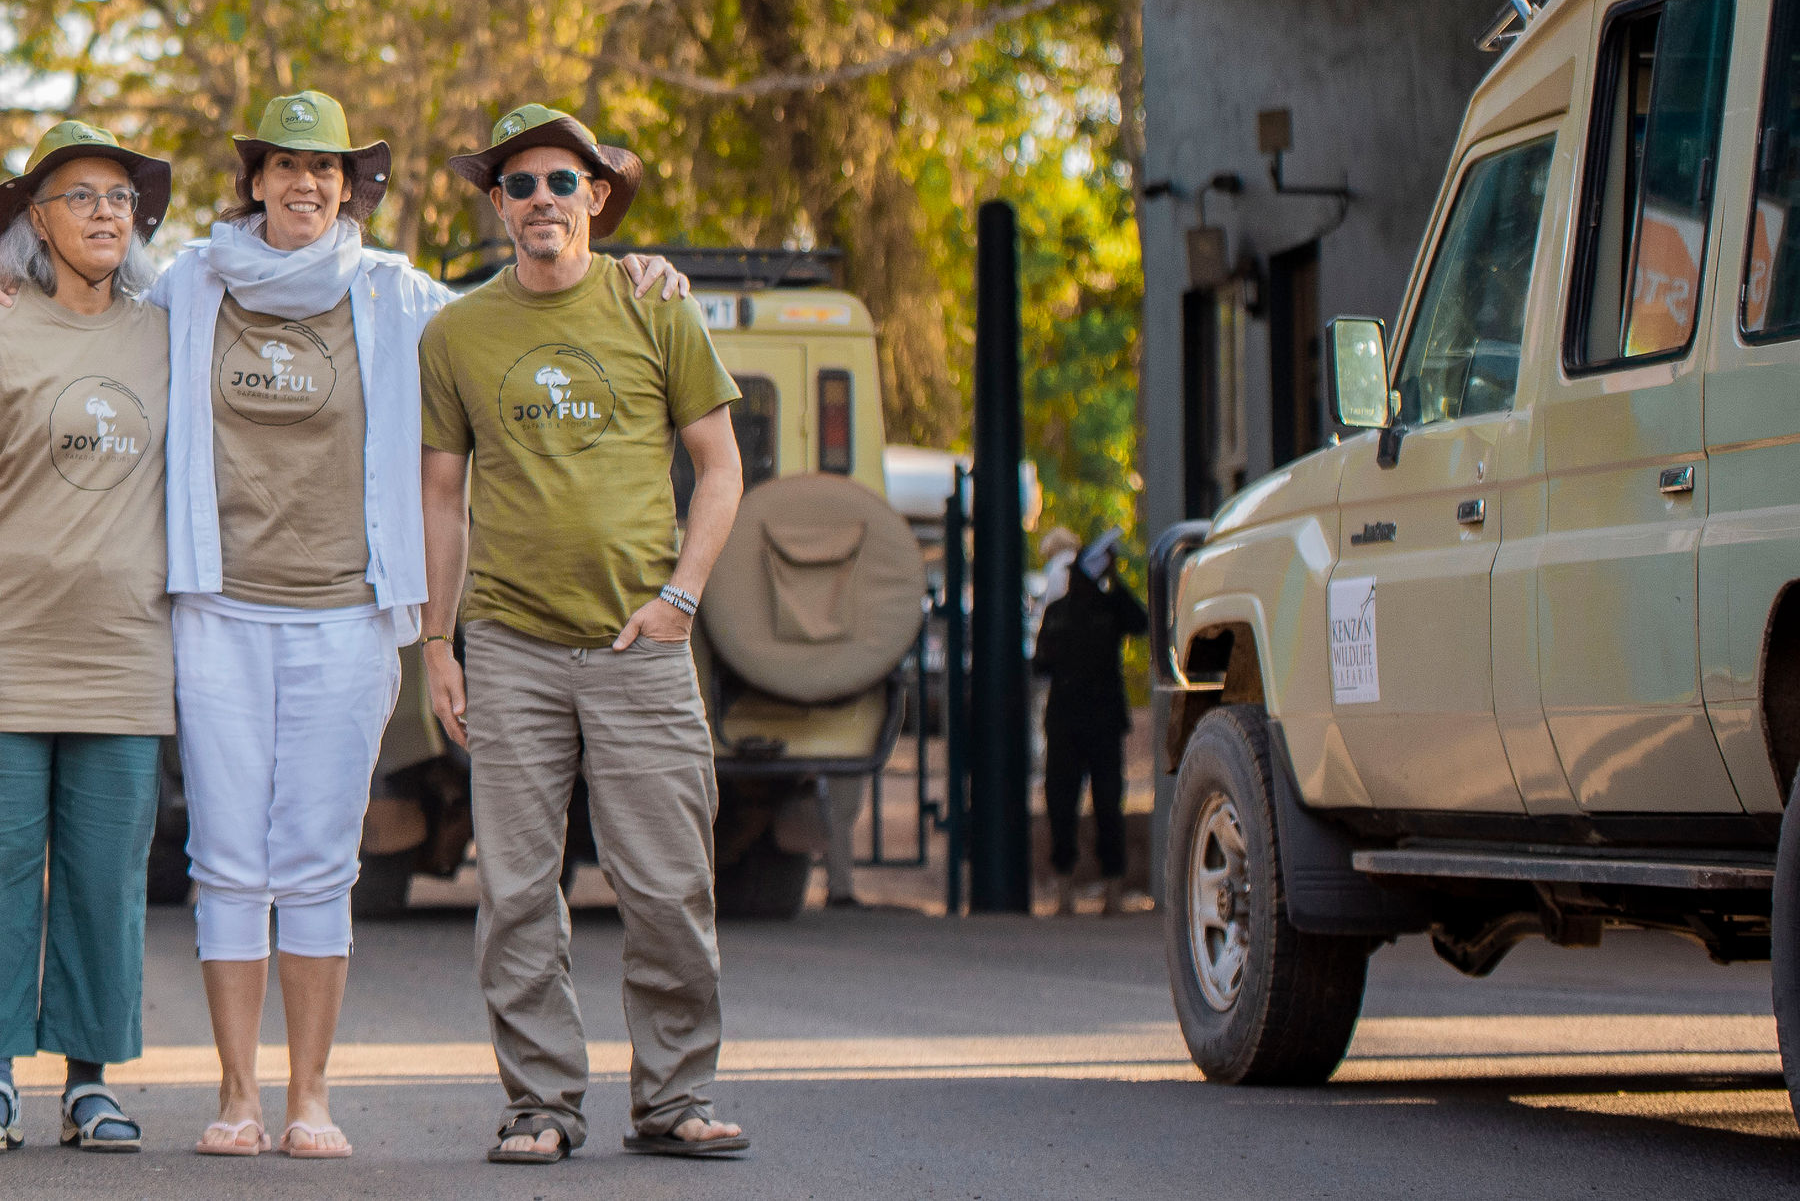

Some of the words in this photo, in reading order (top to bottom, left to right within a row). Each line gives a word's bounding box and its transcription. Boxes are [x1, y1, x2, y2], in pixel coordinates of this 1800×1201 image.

[285, 114, 313, 123] JOYFUL
[231, 370, 318, 392] JOYFUL
[513, 400, 602, 422] JOYFUL
[61, 434, 139, 455] JOYFUL
[1333, 644, 1372, 667] WILDLIFE
[1335, 668, 1374, 687] SAFARIS
